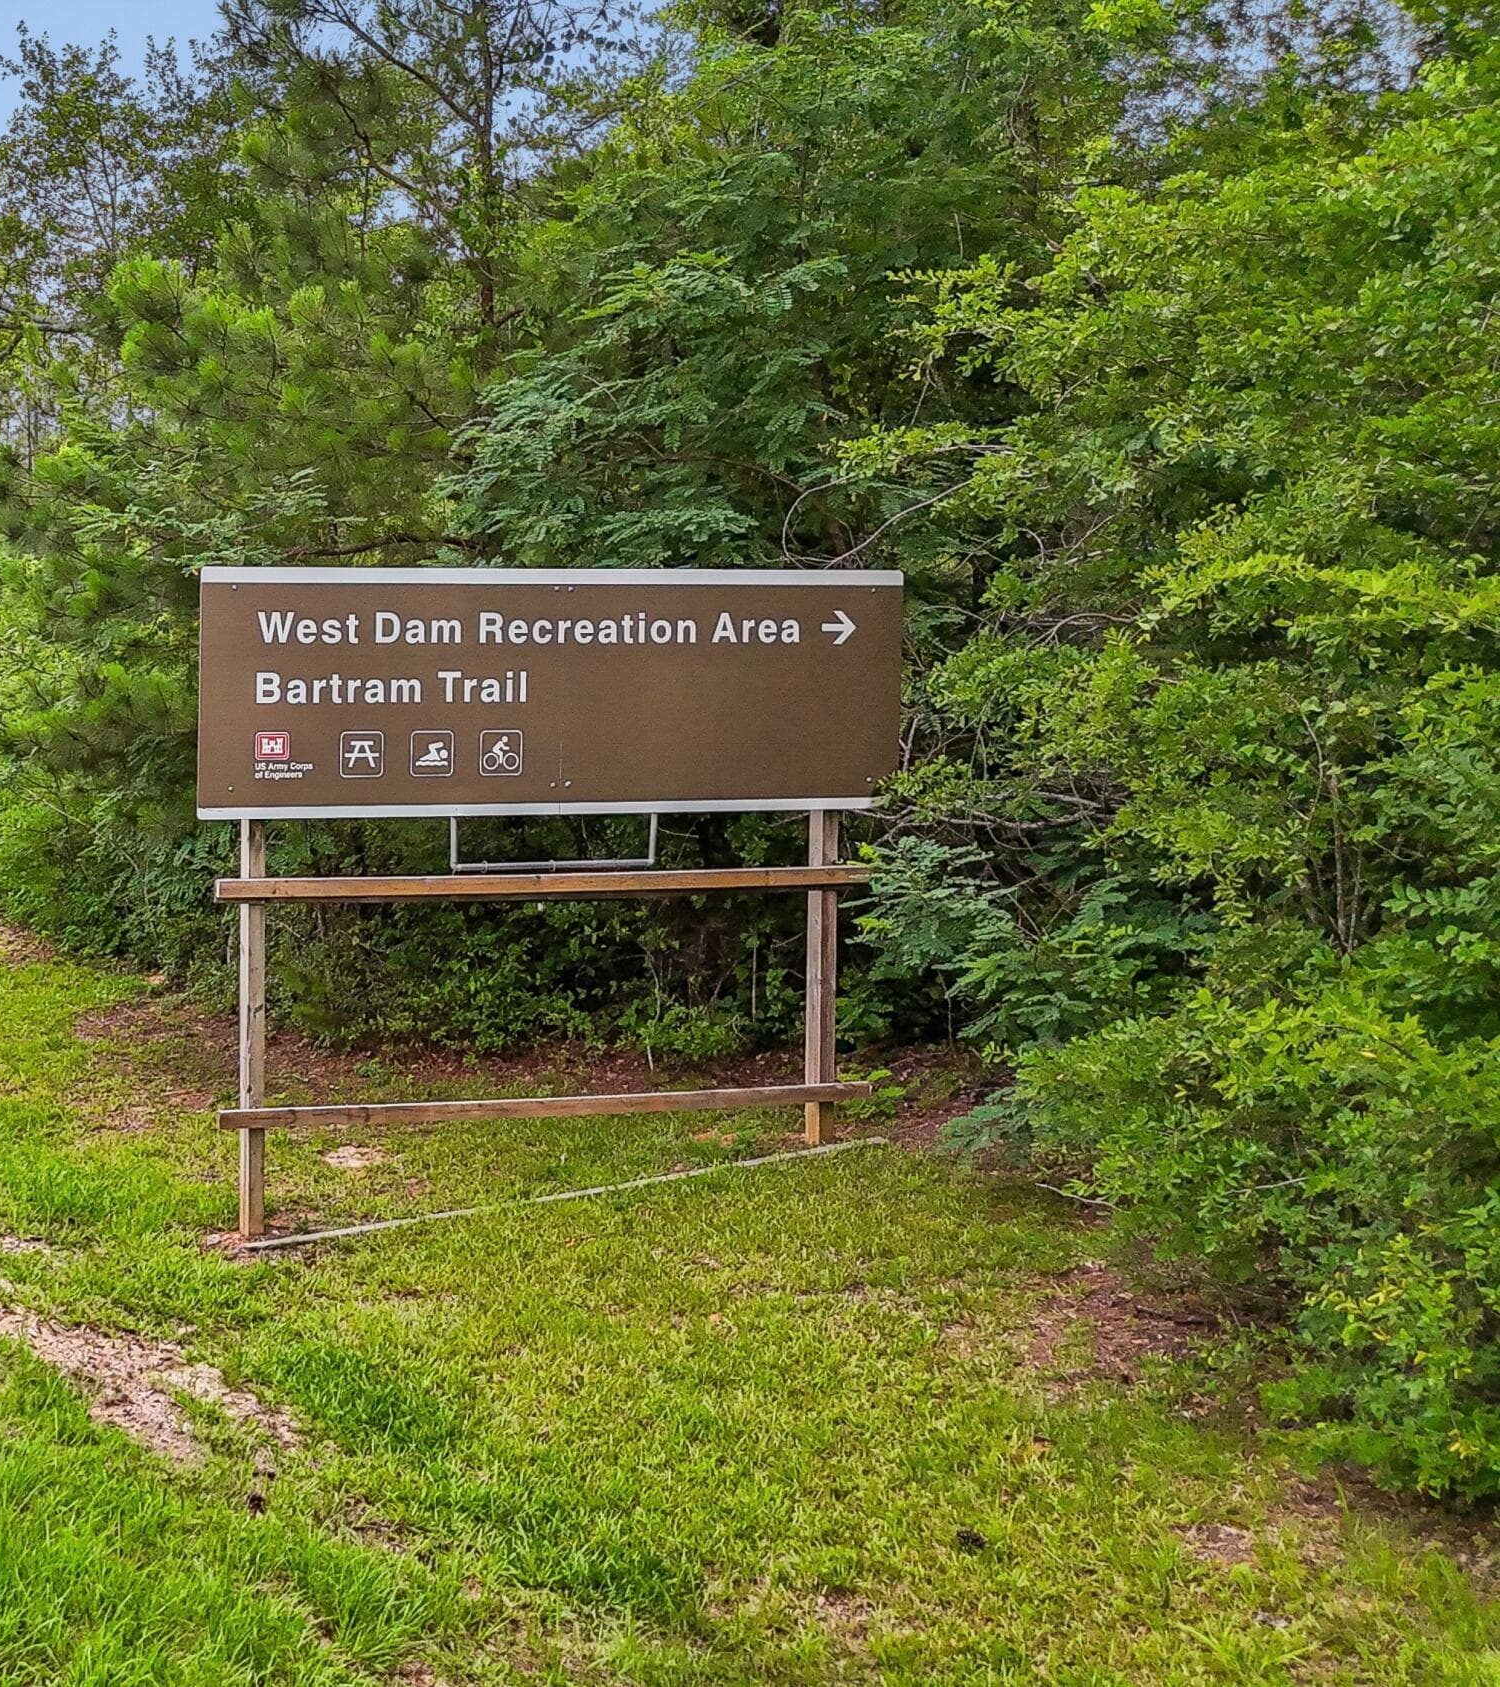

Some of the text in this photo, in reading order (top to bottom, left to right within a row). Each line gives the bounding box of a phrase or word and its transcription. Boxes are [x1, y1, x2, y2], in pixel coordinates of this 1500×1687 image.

[257, 611, 800, 644] West Dam Recreation Area
[255, 671, 528, 704] Bartram Trail
[255, 762, 313, 772] US Army Corps
[255, 771, 303, 780] of Engineers
